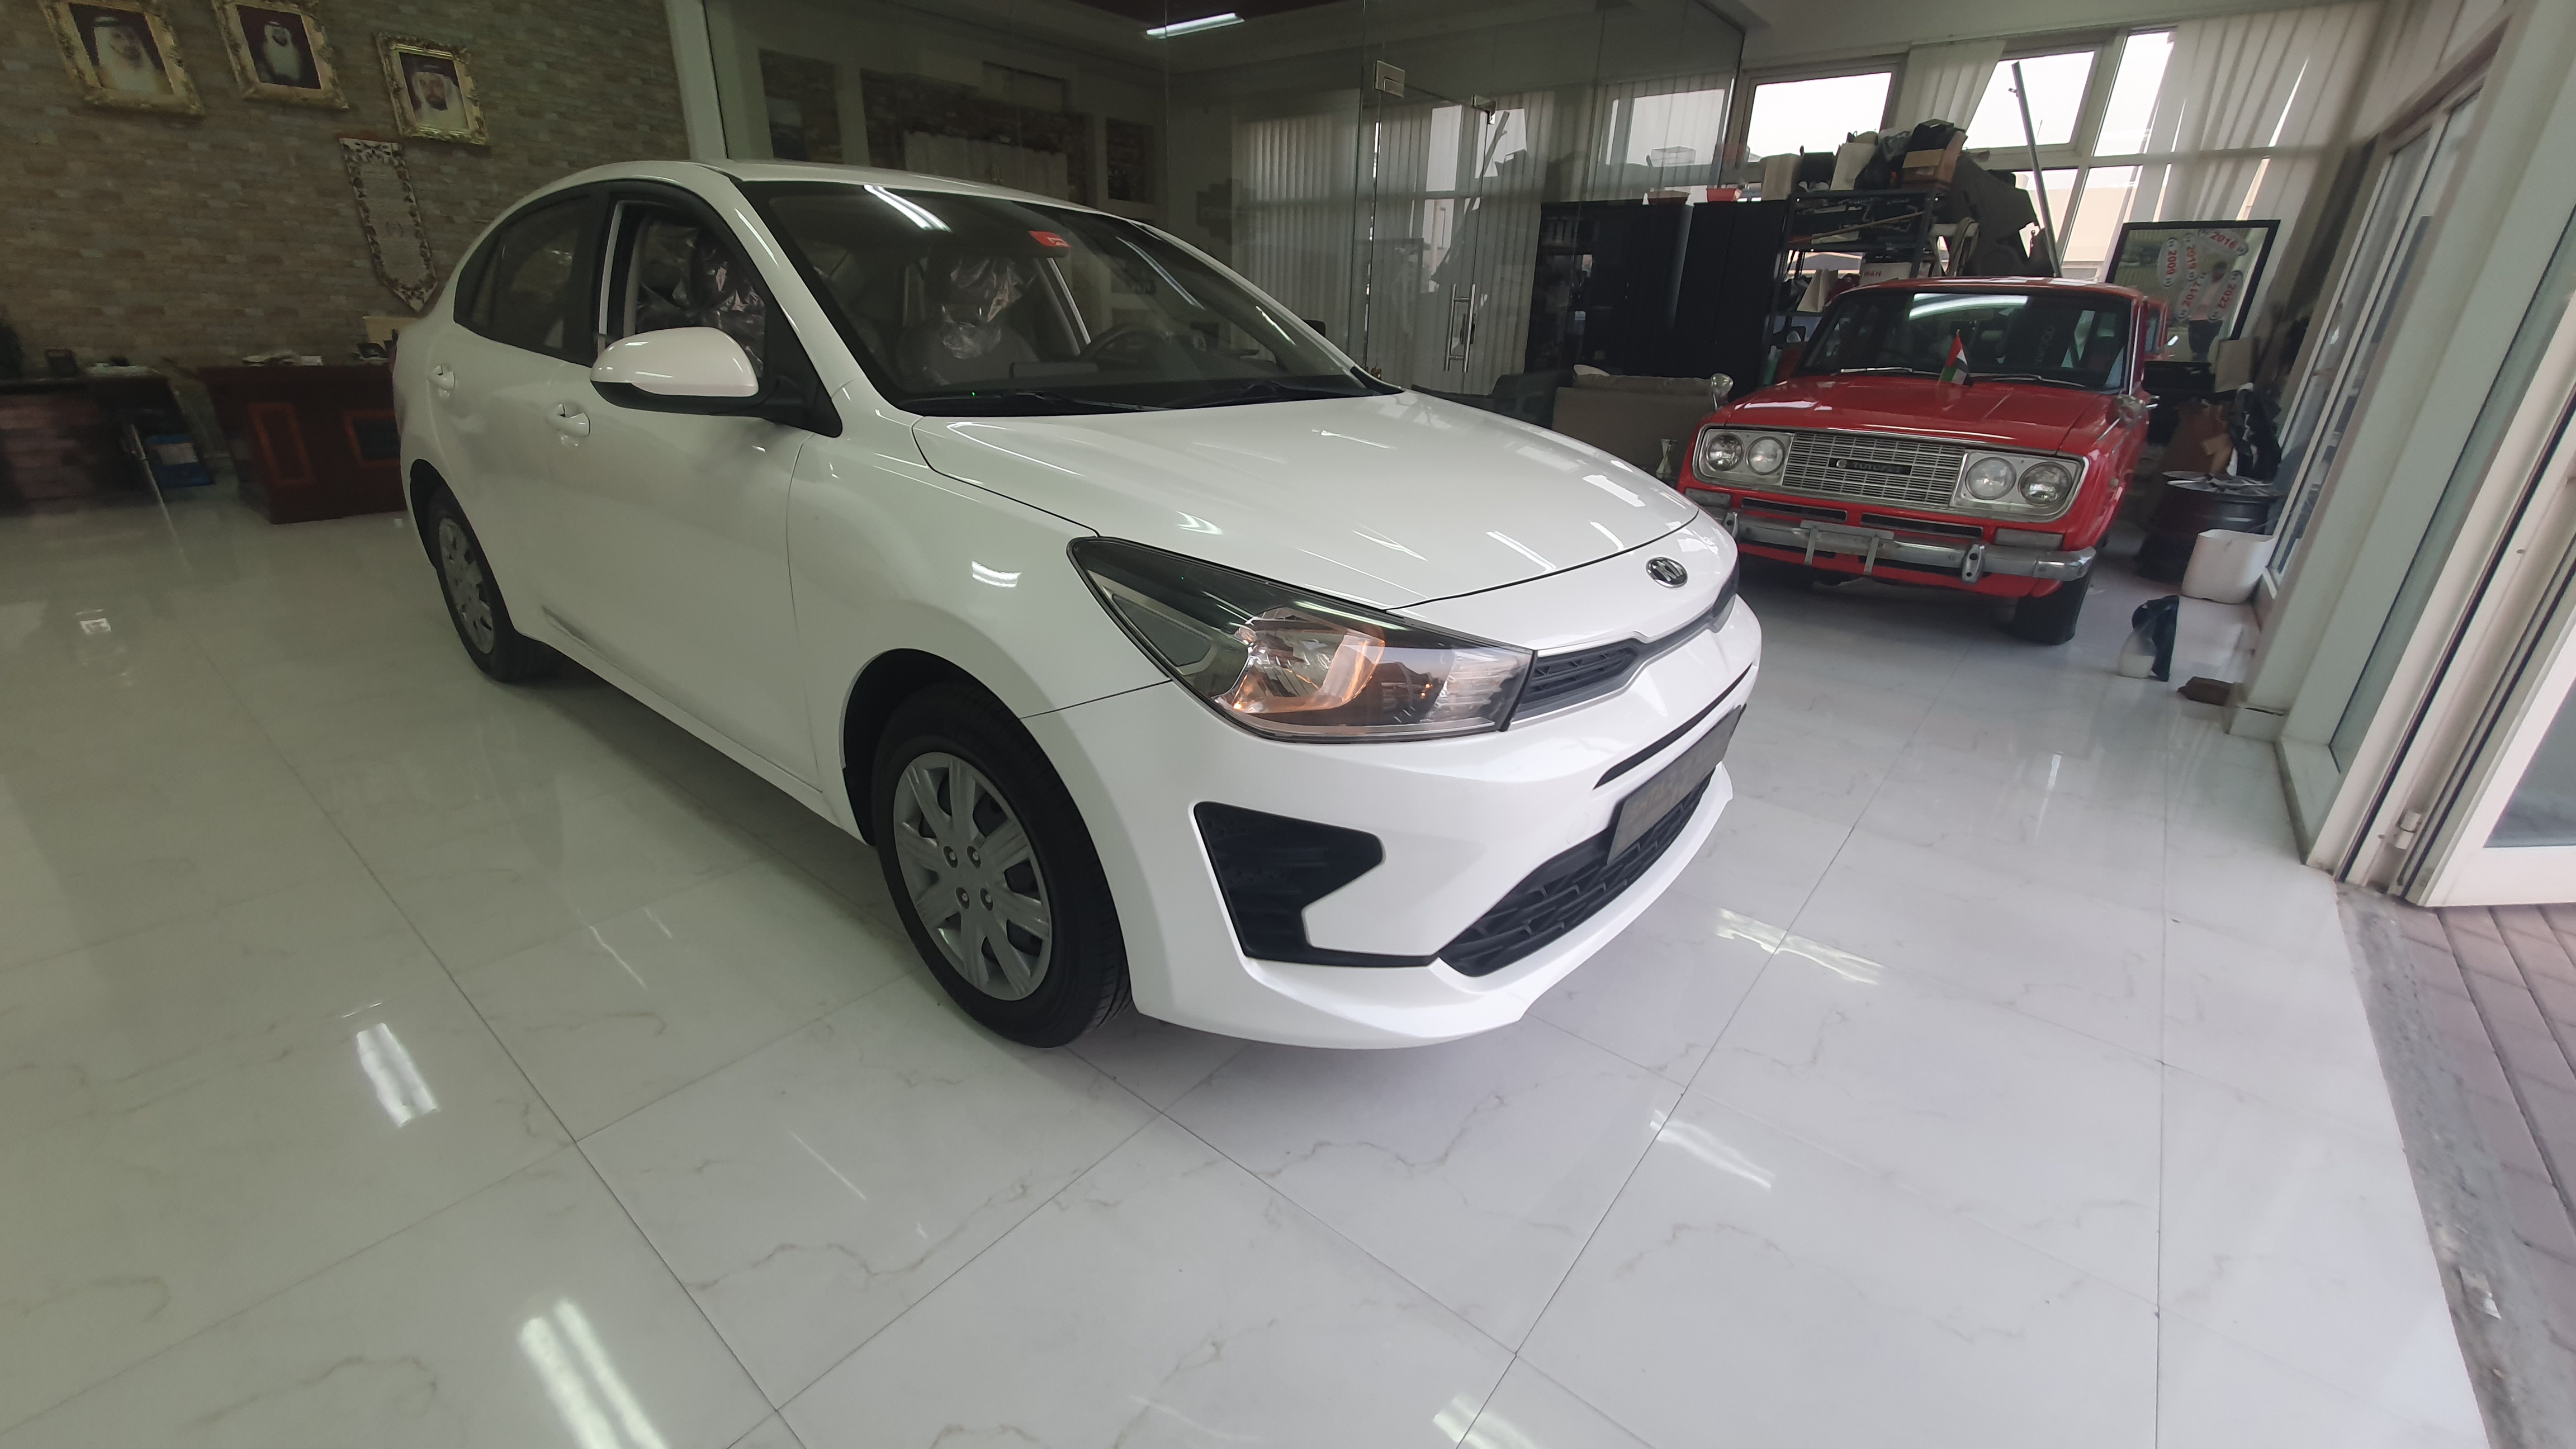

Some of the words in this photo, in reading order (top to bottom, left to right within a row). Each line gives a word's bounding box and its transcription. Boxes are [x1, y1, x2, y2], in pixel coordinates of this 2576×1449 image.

[2210, 232, 2237, 248] 2016
[2167, 250, 2176, 275] 2009
[2218, 283, 2236, 309] 2022
